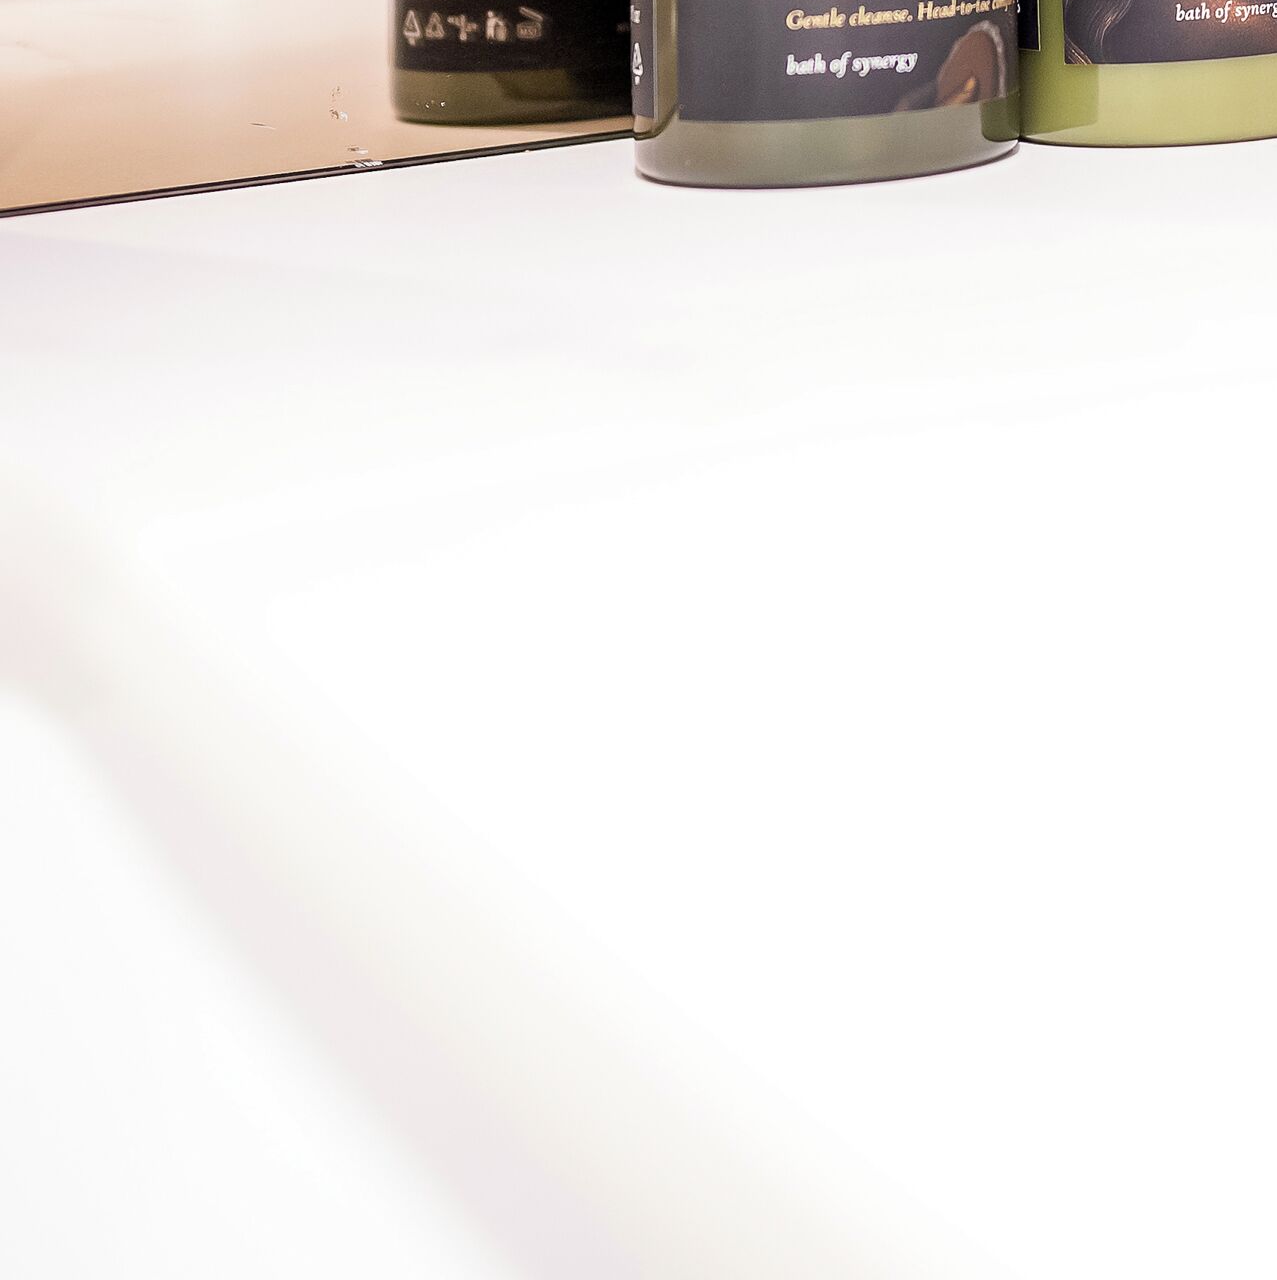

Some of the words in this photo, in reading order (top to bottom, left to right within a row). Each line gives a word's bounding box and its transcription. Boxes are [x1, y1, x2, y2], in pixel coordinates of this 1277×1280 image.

[786, 7, 846, 29] Gentle
[849, 6, 912, 26] cleanse.
[1176, 3, 1210, 22] bath
[1215, 0, 1233, 23] of
[787, 53, 826, 75] bath
[830, 52, 851, 78] of
[852, 53, 917, 76] synergy
